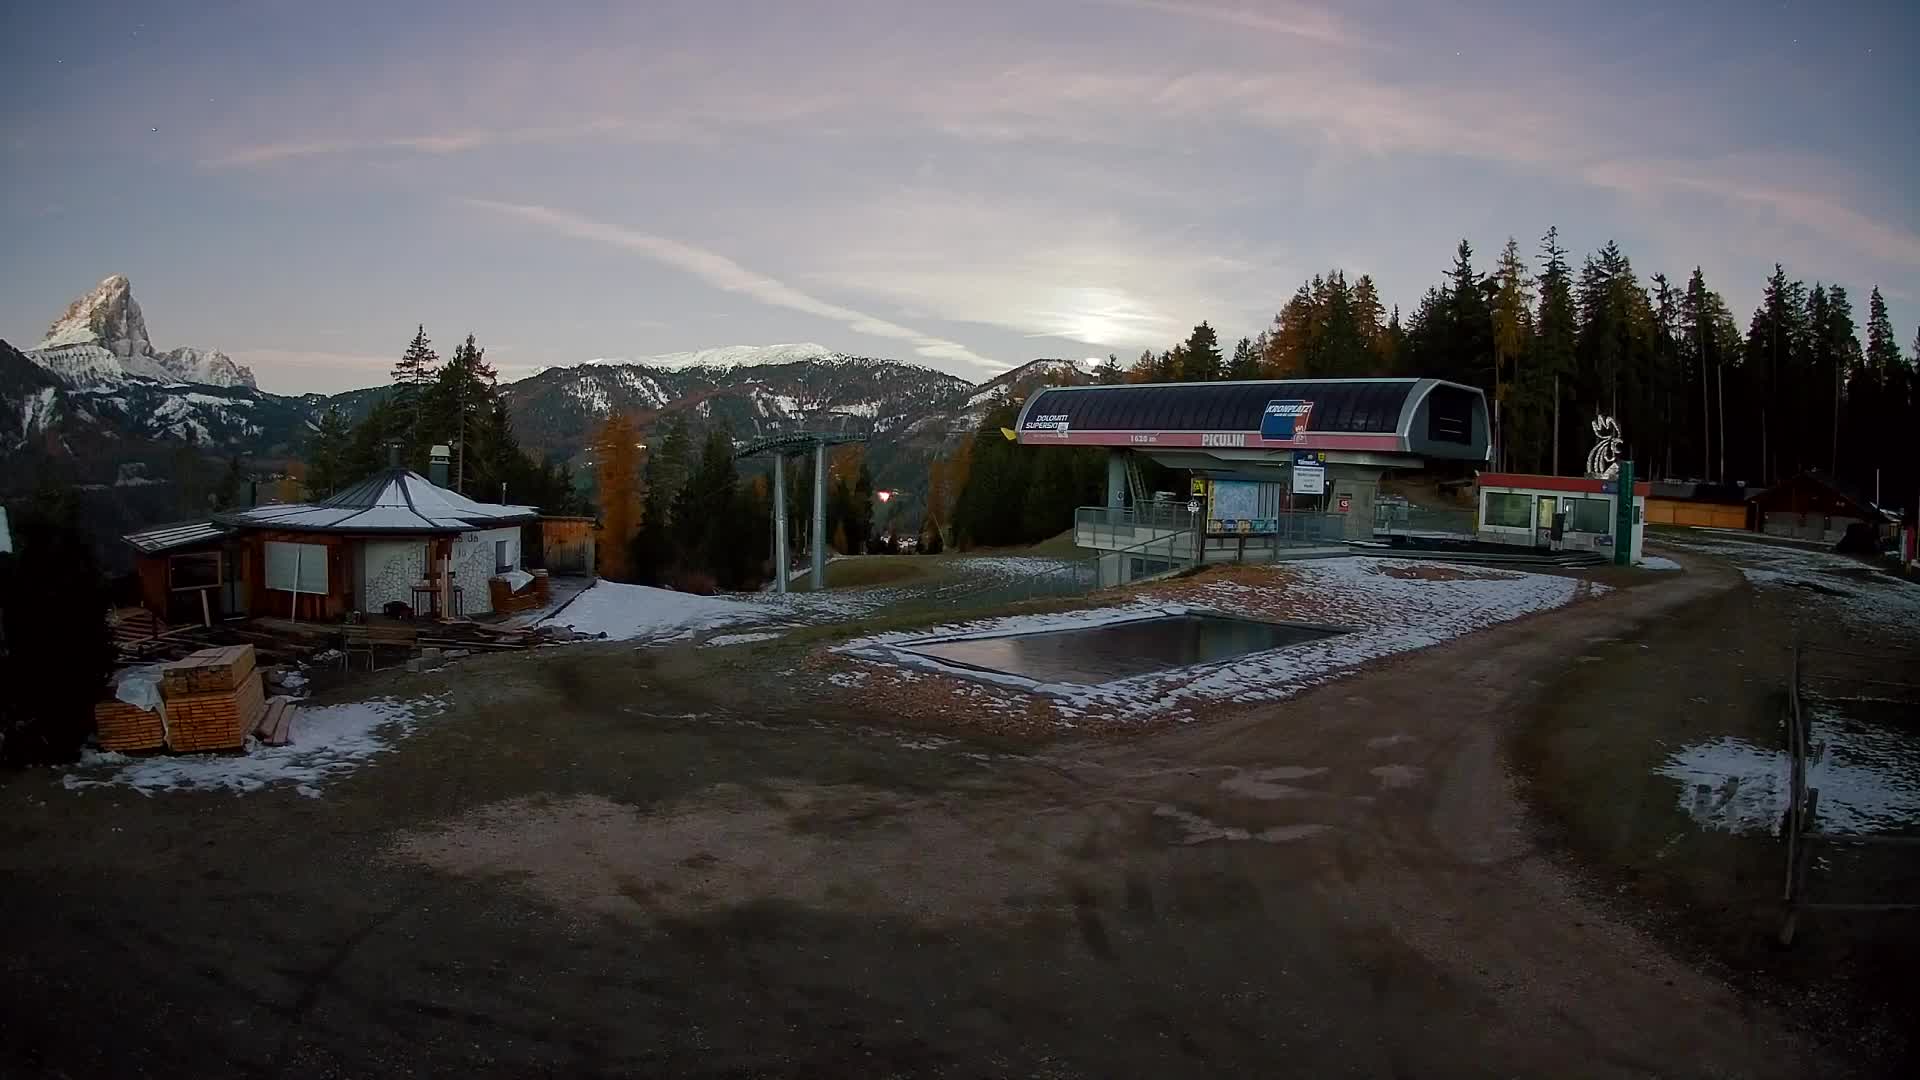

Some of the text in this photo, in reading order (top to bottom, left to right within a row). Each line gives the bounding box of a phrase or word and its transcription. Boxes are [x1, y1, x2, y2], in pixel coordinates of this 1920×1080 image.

[1036, 414, 1069, 422] DOLOMITI
[1025, 421, 1059, 429] SUPERSKI
[1201, 433, 1245, 447] PICULIN
